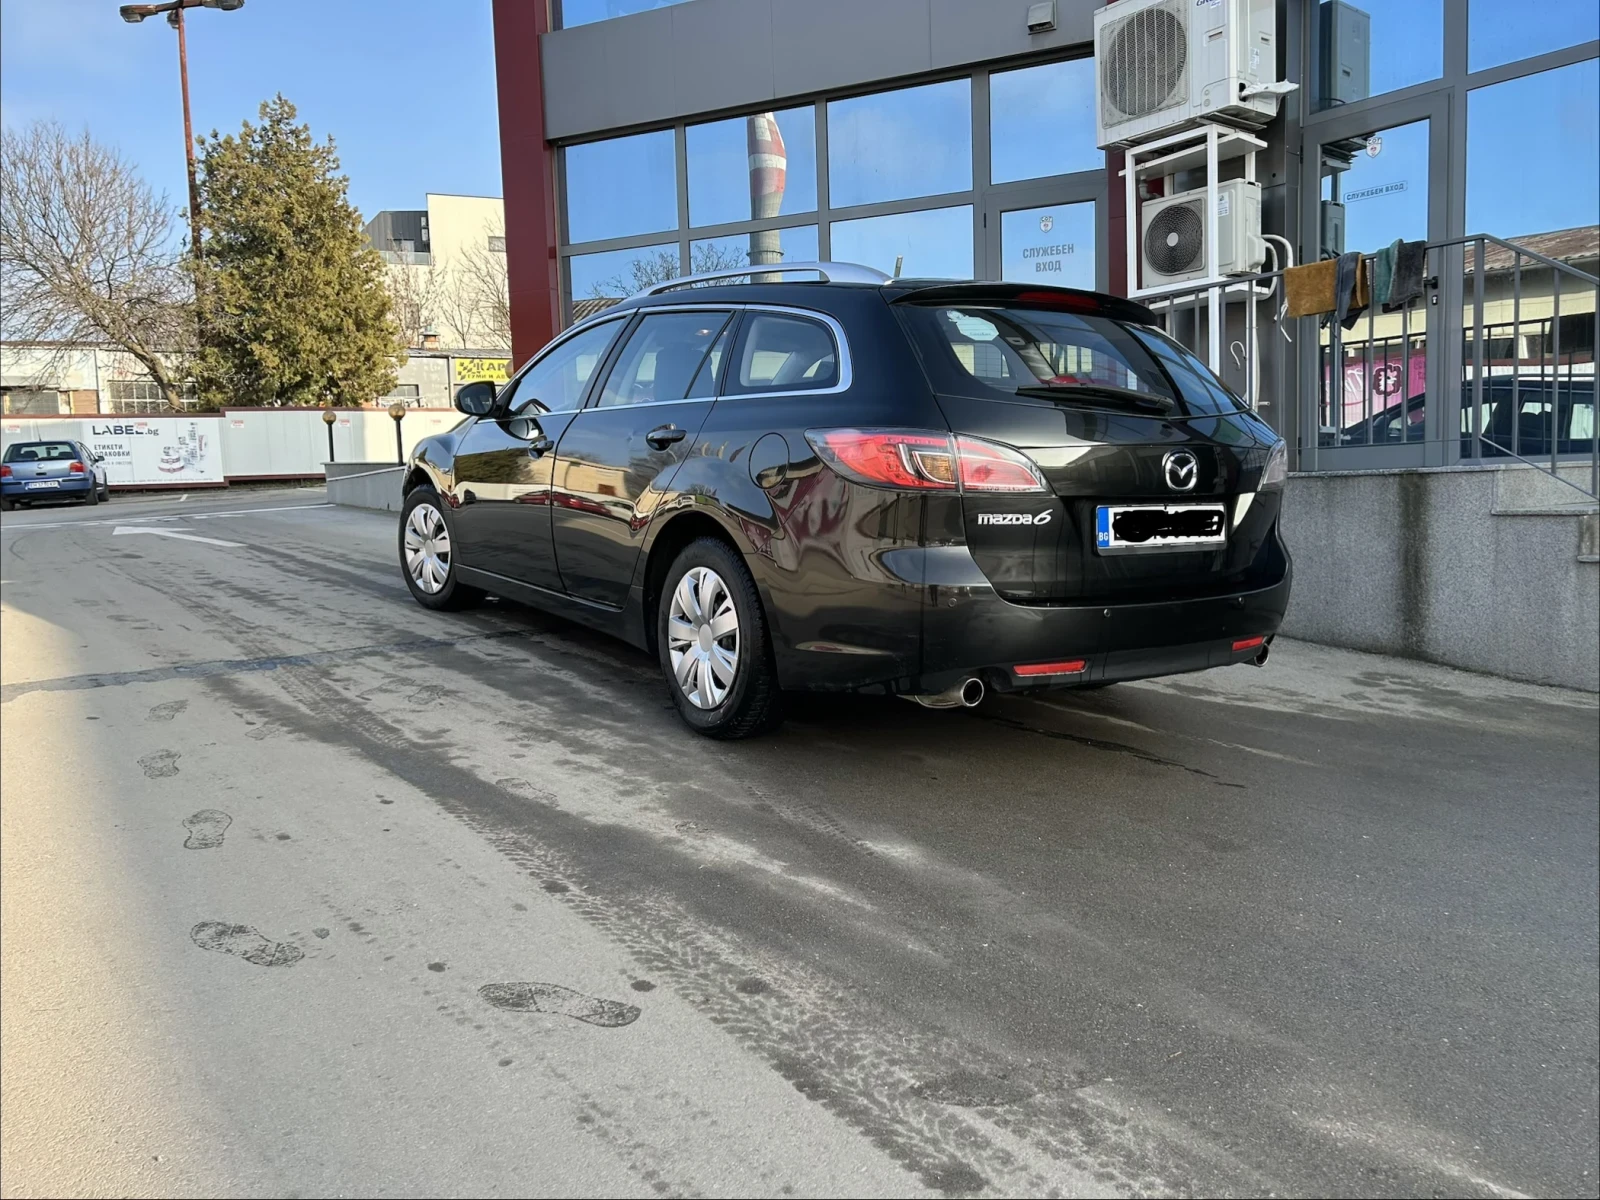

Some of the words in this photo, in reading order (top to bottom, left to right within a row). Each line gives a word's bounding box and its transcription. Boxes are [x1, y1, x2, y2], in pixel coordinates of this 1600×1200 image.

[1346, 186, 1384, 201] СЛУЖЕБЕН
[1385, 182, 1404, 193] ВХОД
[1022, 243, 1075, 259] СЛУЖЕБЕН
[1035, 259, 1062, 273] ВХОД
[1098, 532, 1109, 541] BG
